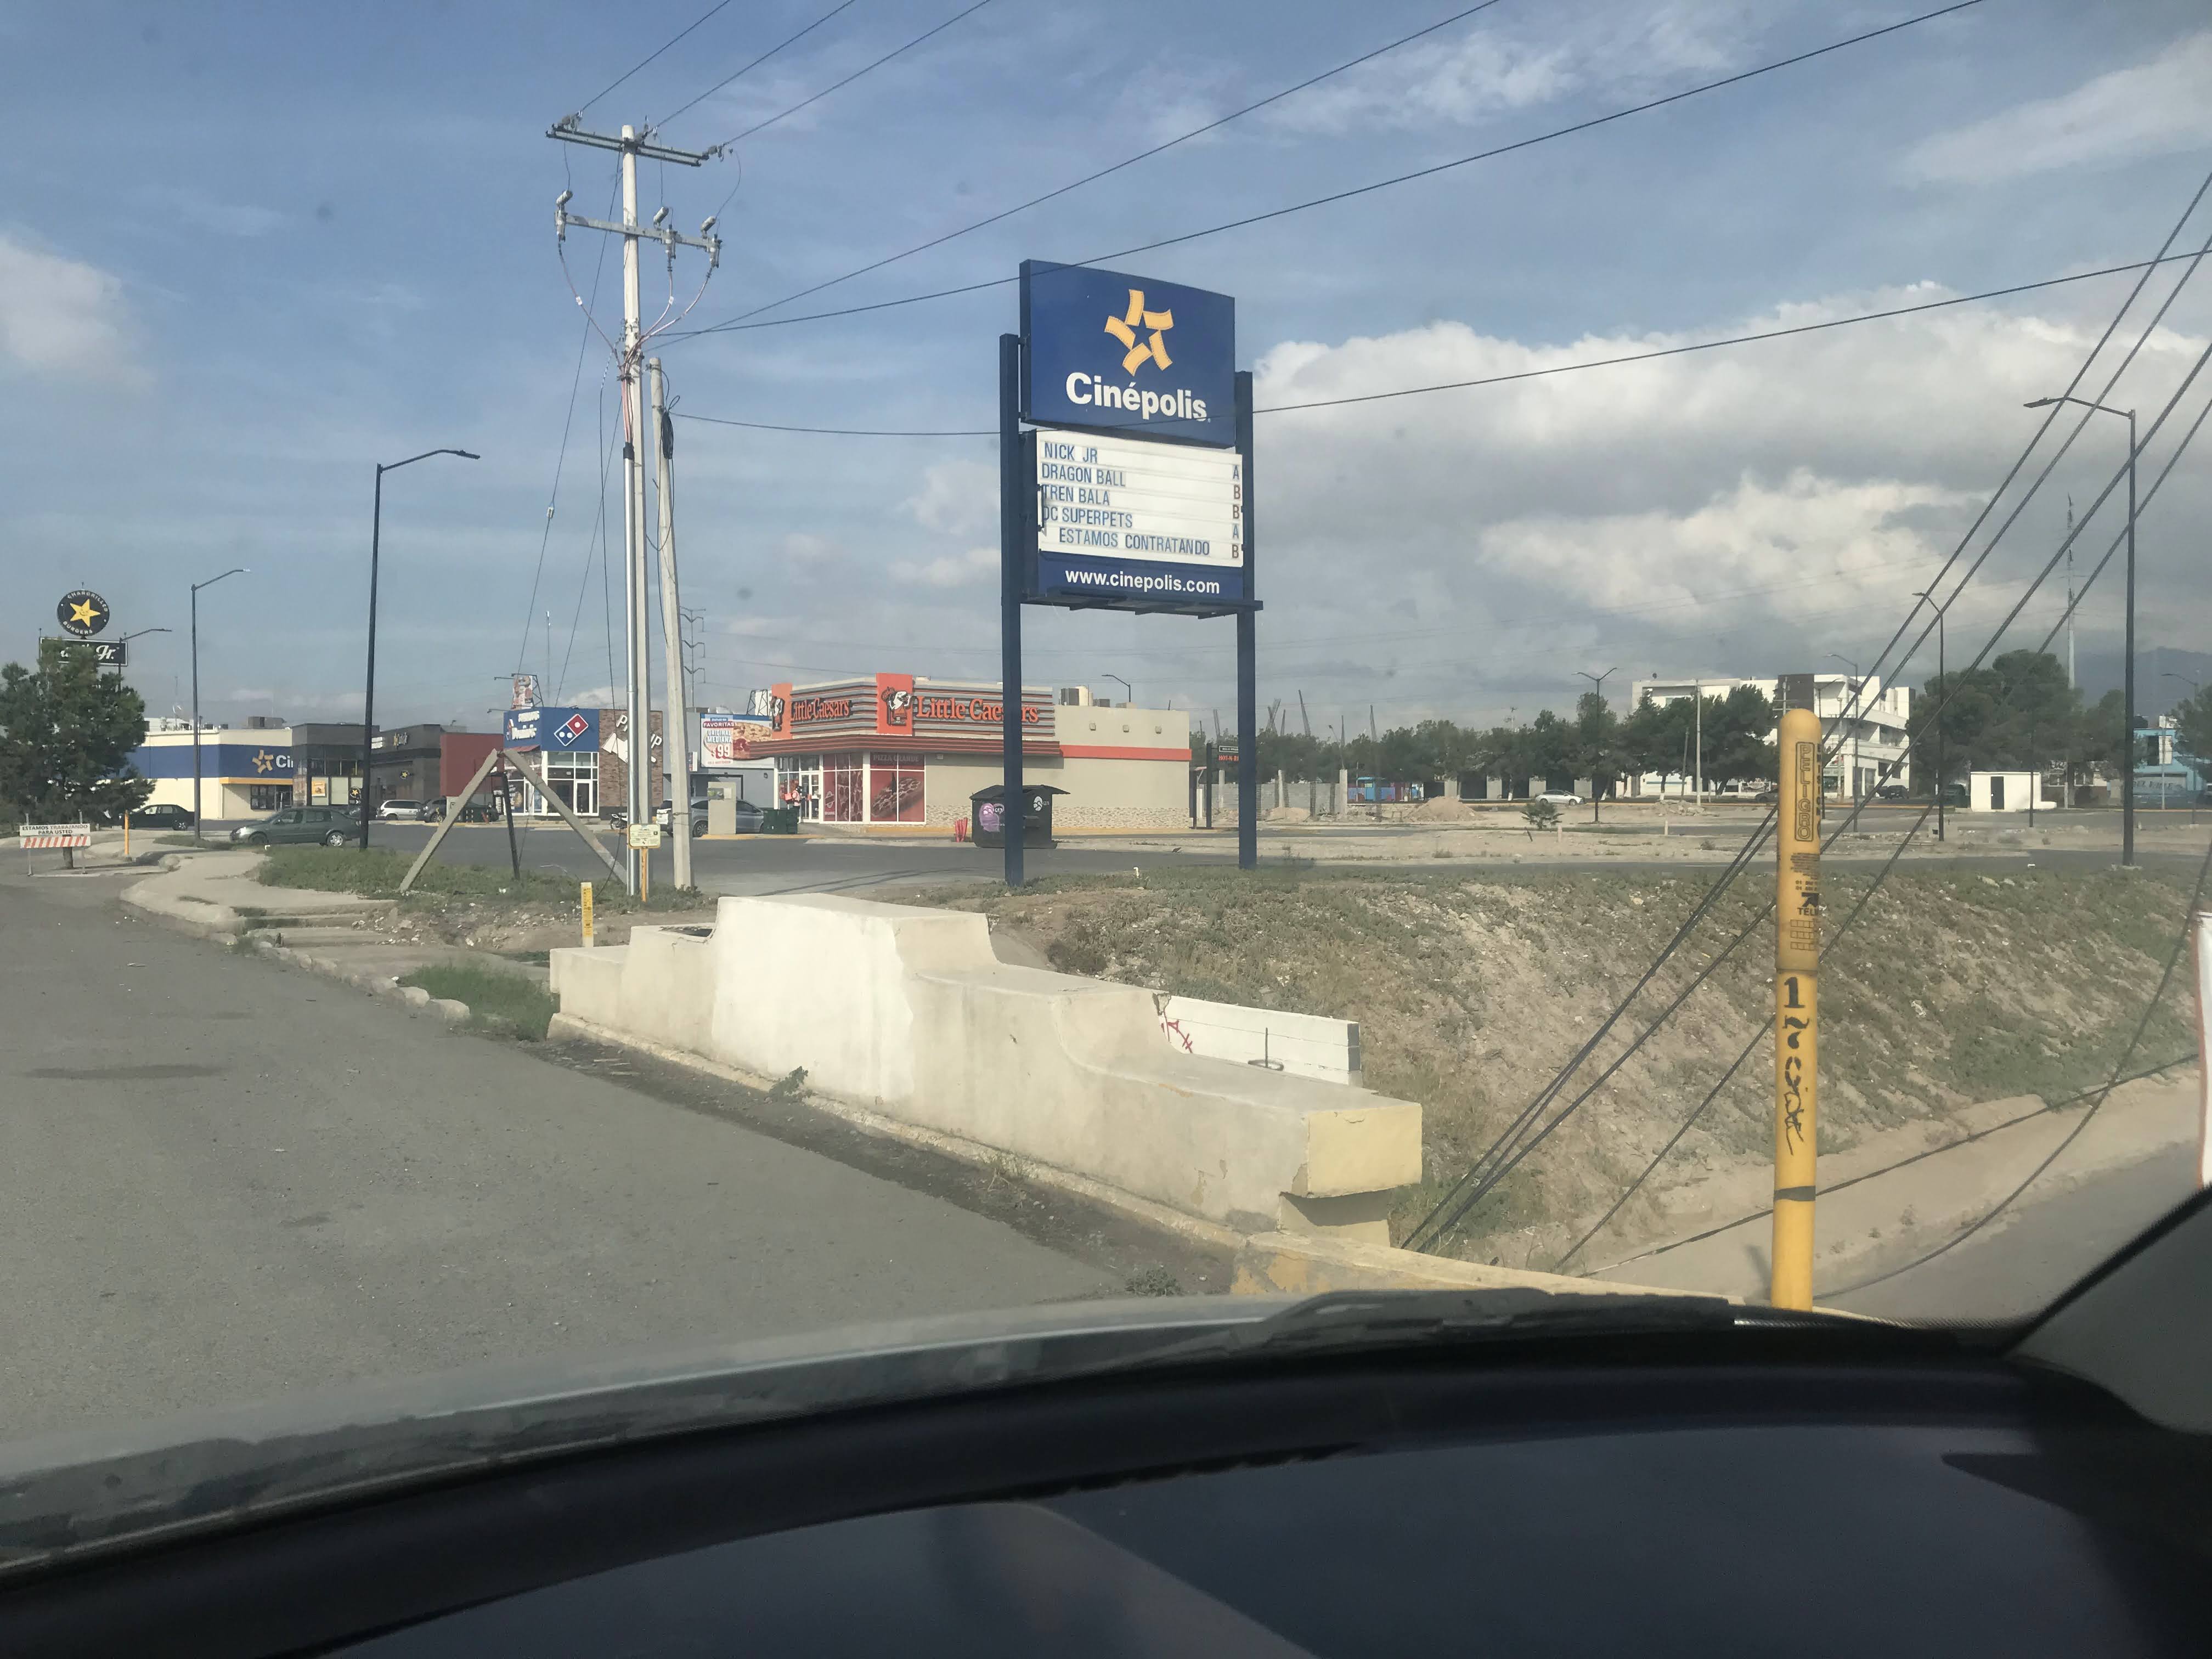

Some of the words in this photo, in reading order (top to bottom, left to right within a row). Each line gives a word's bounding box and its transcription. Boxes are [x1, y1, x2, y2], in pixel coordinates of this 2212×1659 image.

[1065, 372, 1207, 422] Cinépolis
[1044, 442, 1075, 461] NICK
[1082, 448, 1097, 464] JR
[1233, 465, 1239, 479] A
[1041, 463, 1092, 483] DRAGON
[1097, 470, 1126, 487] BALL
[1233, 484, 1240, 500] B
[1042, 484, 1074, 502] TREN
[1079, 488, 1110, 506] BALA
[1233, 504, 1239, 519] B
[1062, 507, 1133, 528] SUPERPETS
[1233, 524, 1239, 539] A
[1059, 528, 1118, 548] ESTAMOS
[1125, 534, 1210, 556] CONTRATANDO
[1232, 544, 1239, 558] B
[1065, 570, 1220, 594] www.cinepolis.com
[63, 620, 93, 634] BURGERS
[791, 698, 812, 721] Little
[813, 697, 850, 720] Caesars
[916, 695, 966, 720] Little
[969, 698, 1039, 724] Caers
[1797, 744, 1811, 839] PELIGRO
